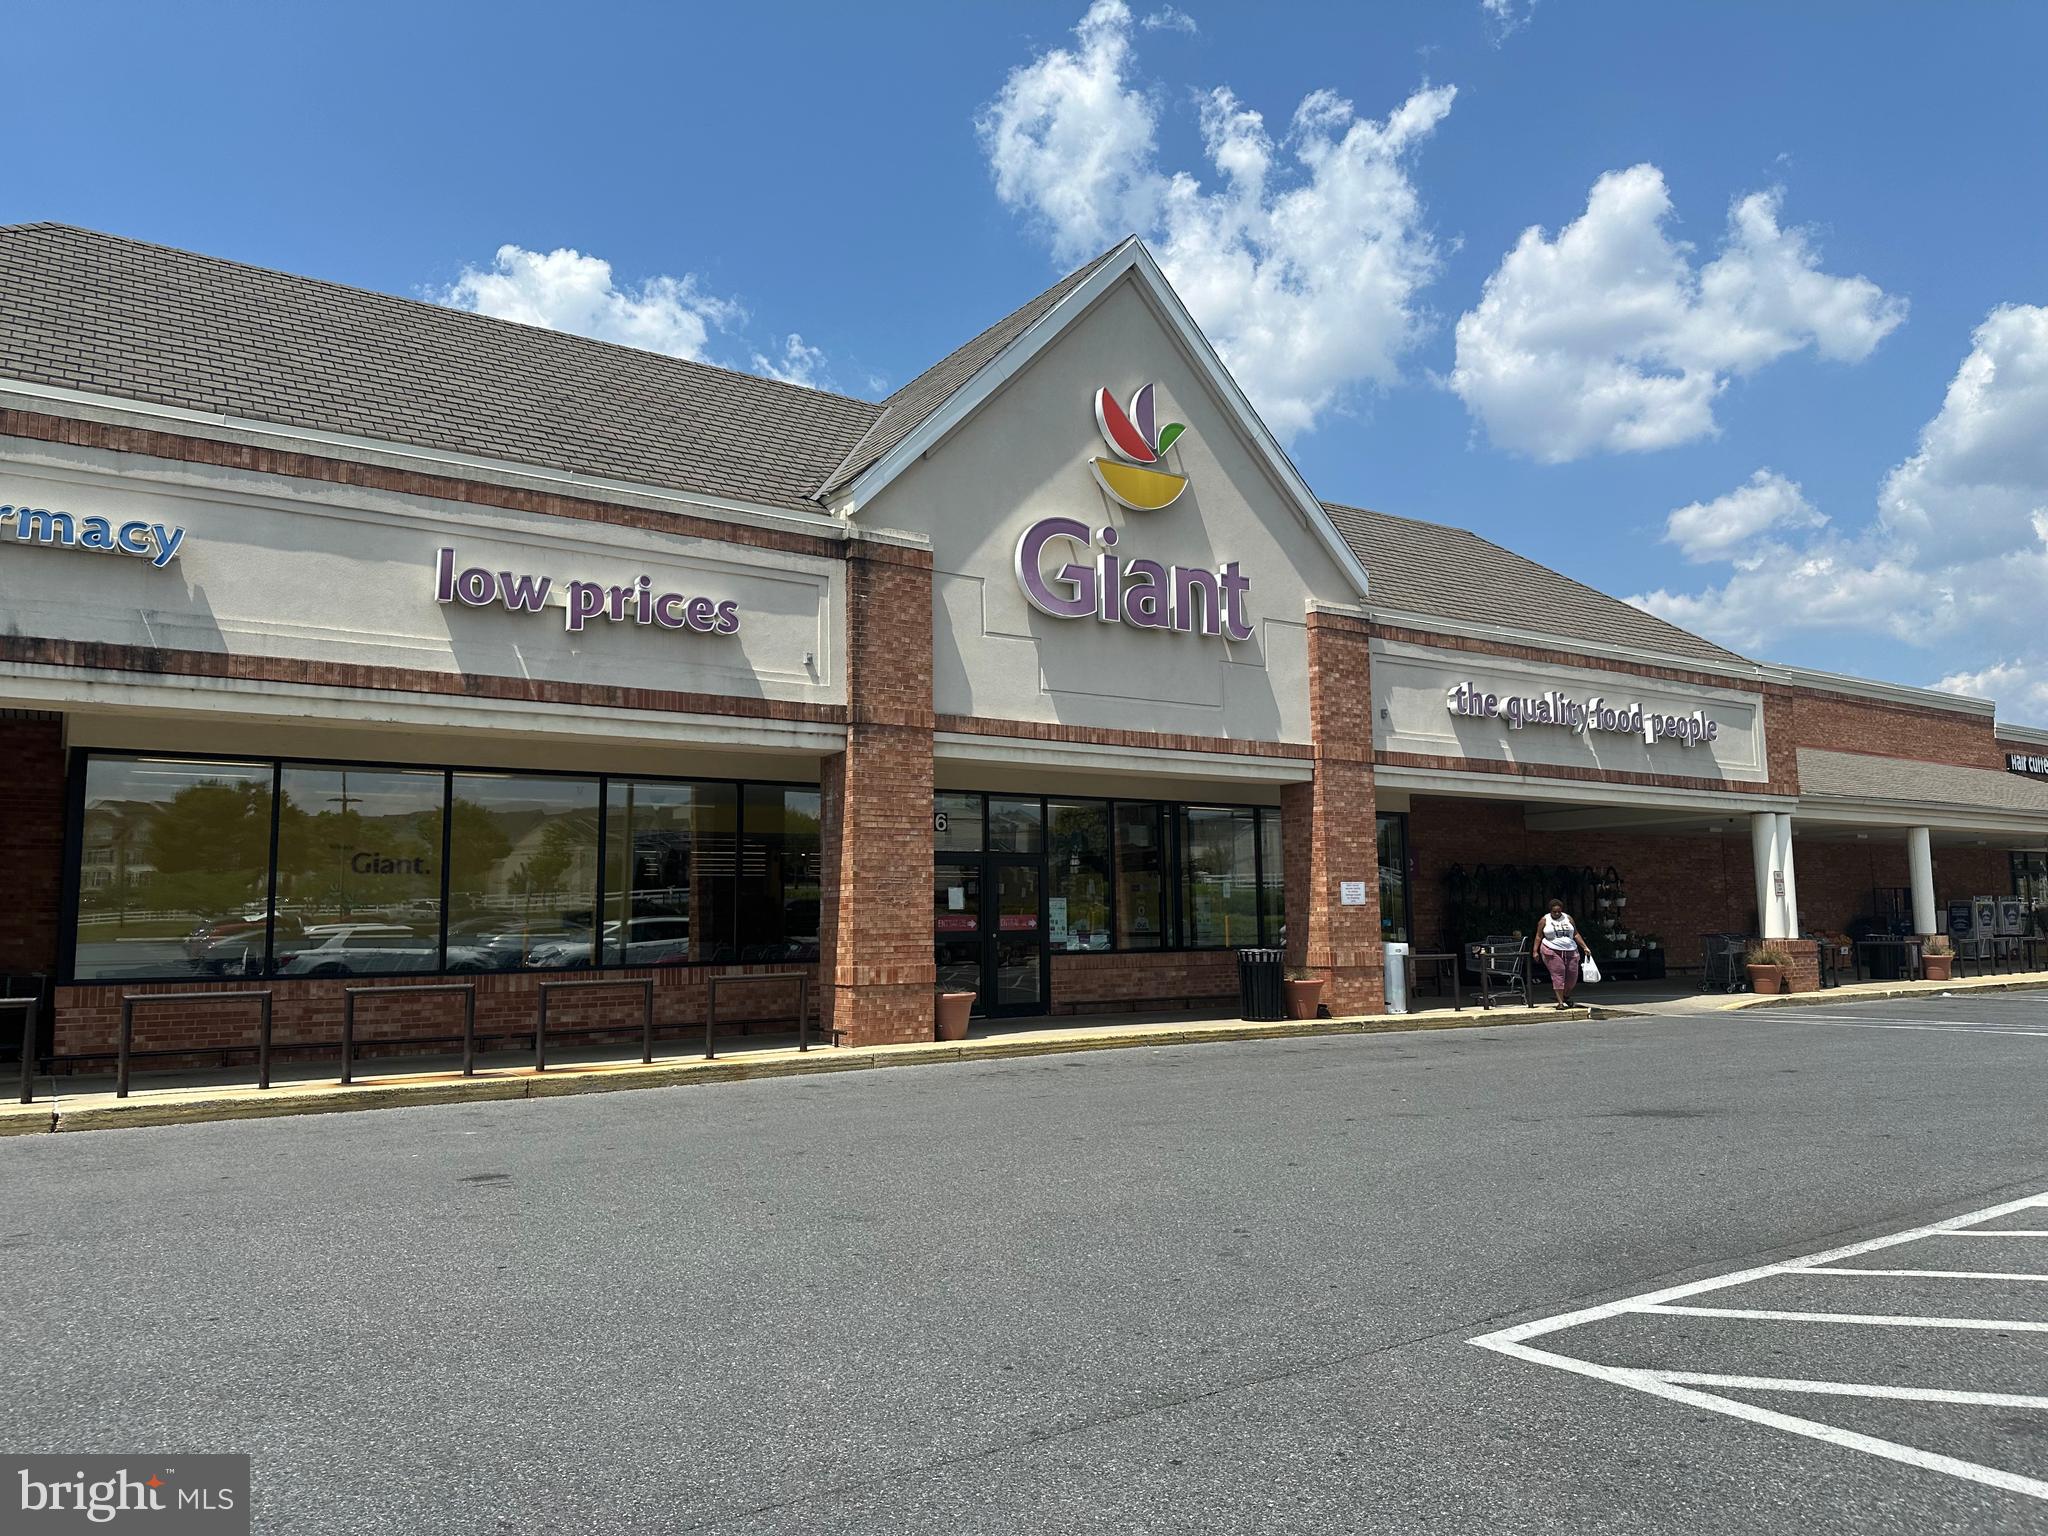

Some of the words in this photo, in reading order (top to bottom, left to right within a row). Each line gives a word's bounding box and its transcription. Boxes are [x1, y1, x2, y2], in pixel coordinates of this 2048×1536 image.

[434, 547, 553, 612] low
[565, 575, 741, 635] prices
[1014, 516, 1256, 641] Giant
[1448, 682, 1499, 717] the
[1501, 691, 1588, 735] quality
[1589, 697, 1645, 734] food
[1645, 710, 1718, 748] people
[935, 813, 947, 831] 6
